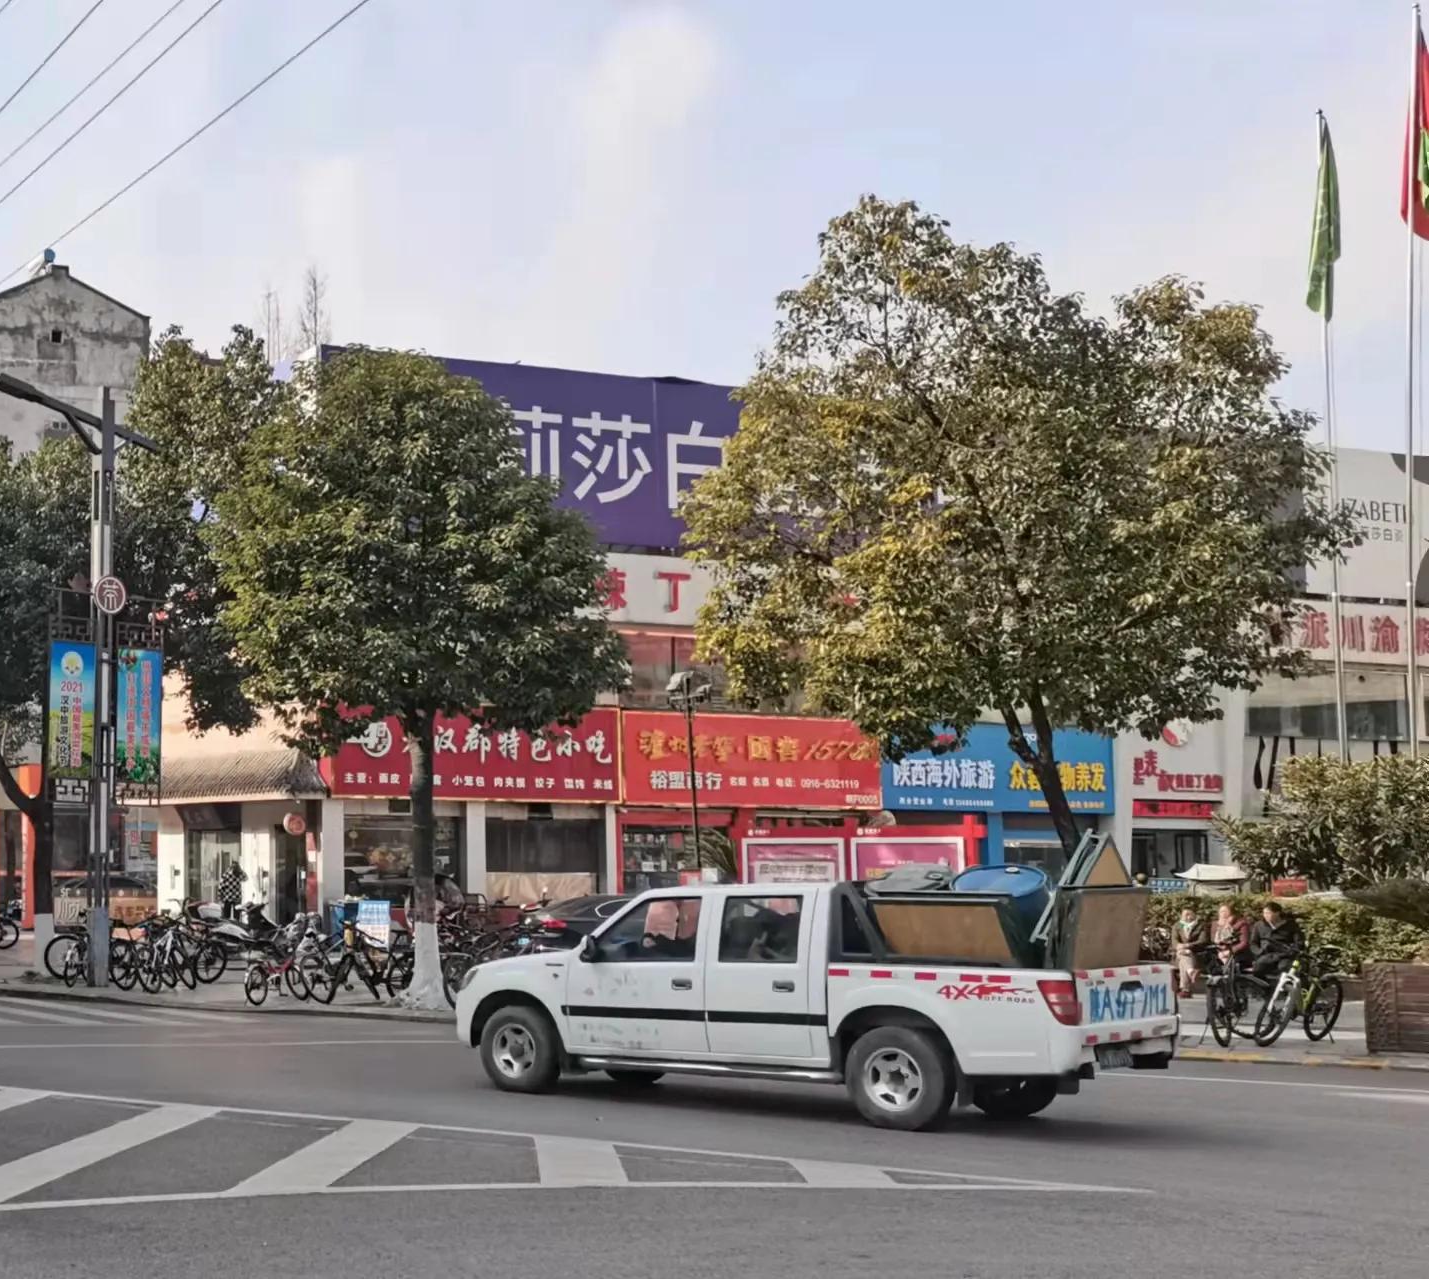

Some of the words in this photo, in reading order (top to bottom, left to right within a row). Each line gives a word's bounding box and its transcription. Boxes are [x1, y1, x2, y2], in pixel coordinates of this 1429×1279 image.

[61, 680, 83, 693] 2021
[402, 723, 613, 764] 汉郡特色小吃
[892, 757, 996, 790] 陕西海外旅游
